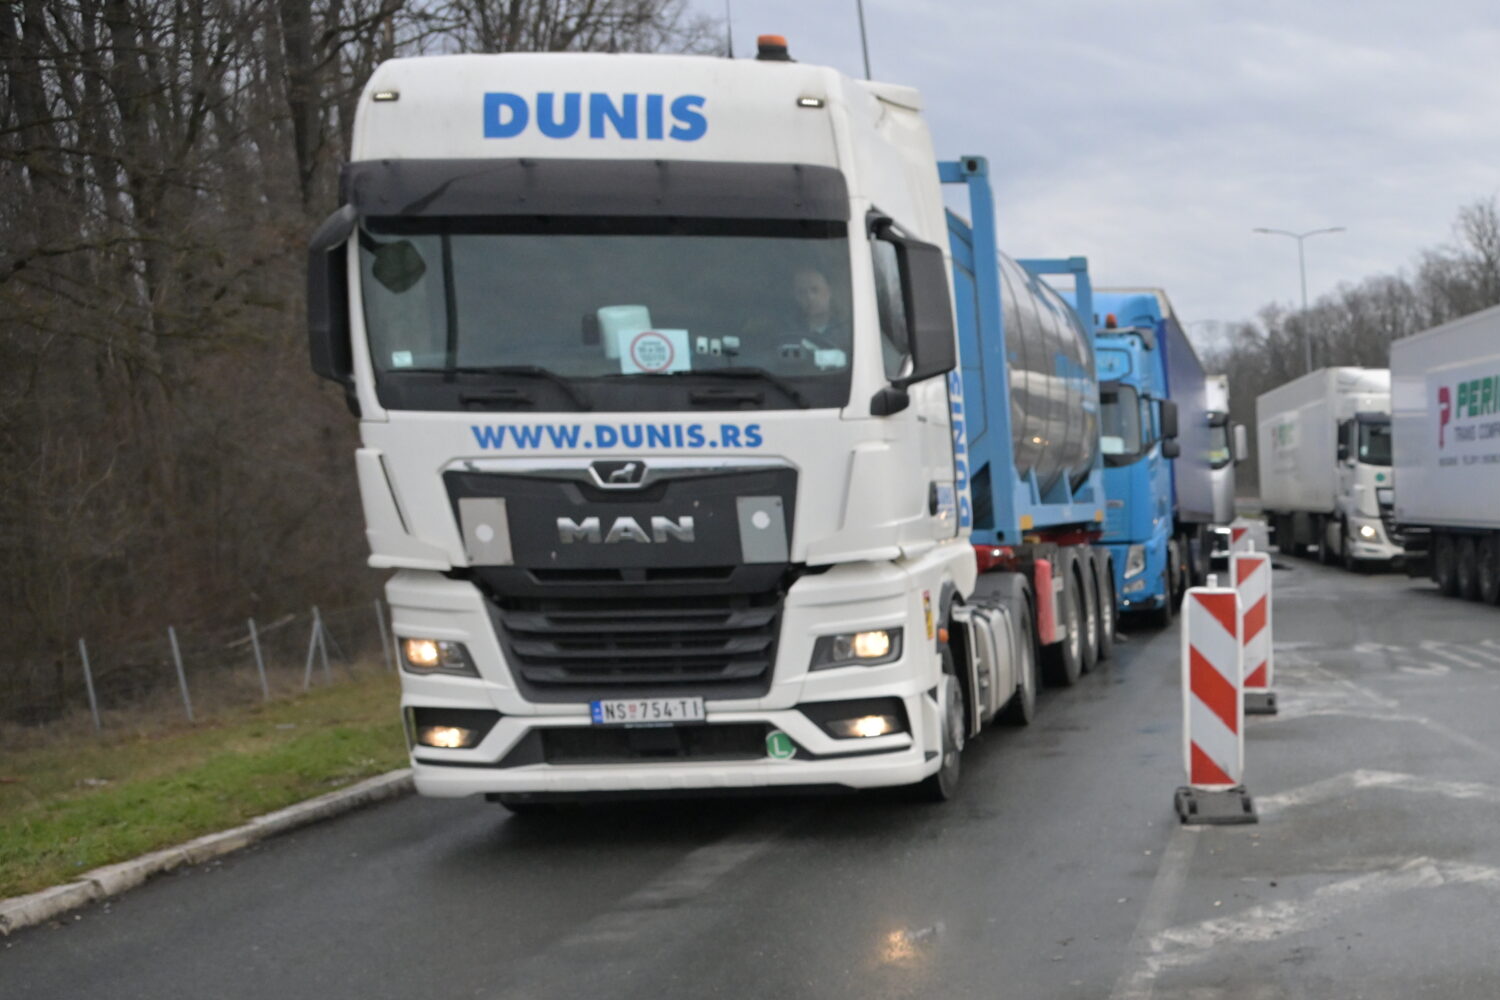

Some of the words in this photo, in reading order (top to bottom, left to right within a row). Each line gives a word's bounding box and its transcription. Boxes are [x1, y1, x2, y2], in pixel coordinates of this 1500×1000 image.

[483, 92, 708, 142] DUNIS
[471, 424, 763, 449] WWW.DUNIS.RS
[557, 516, 695, 543] MAN
